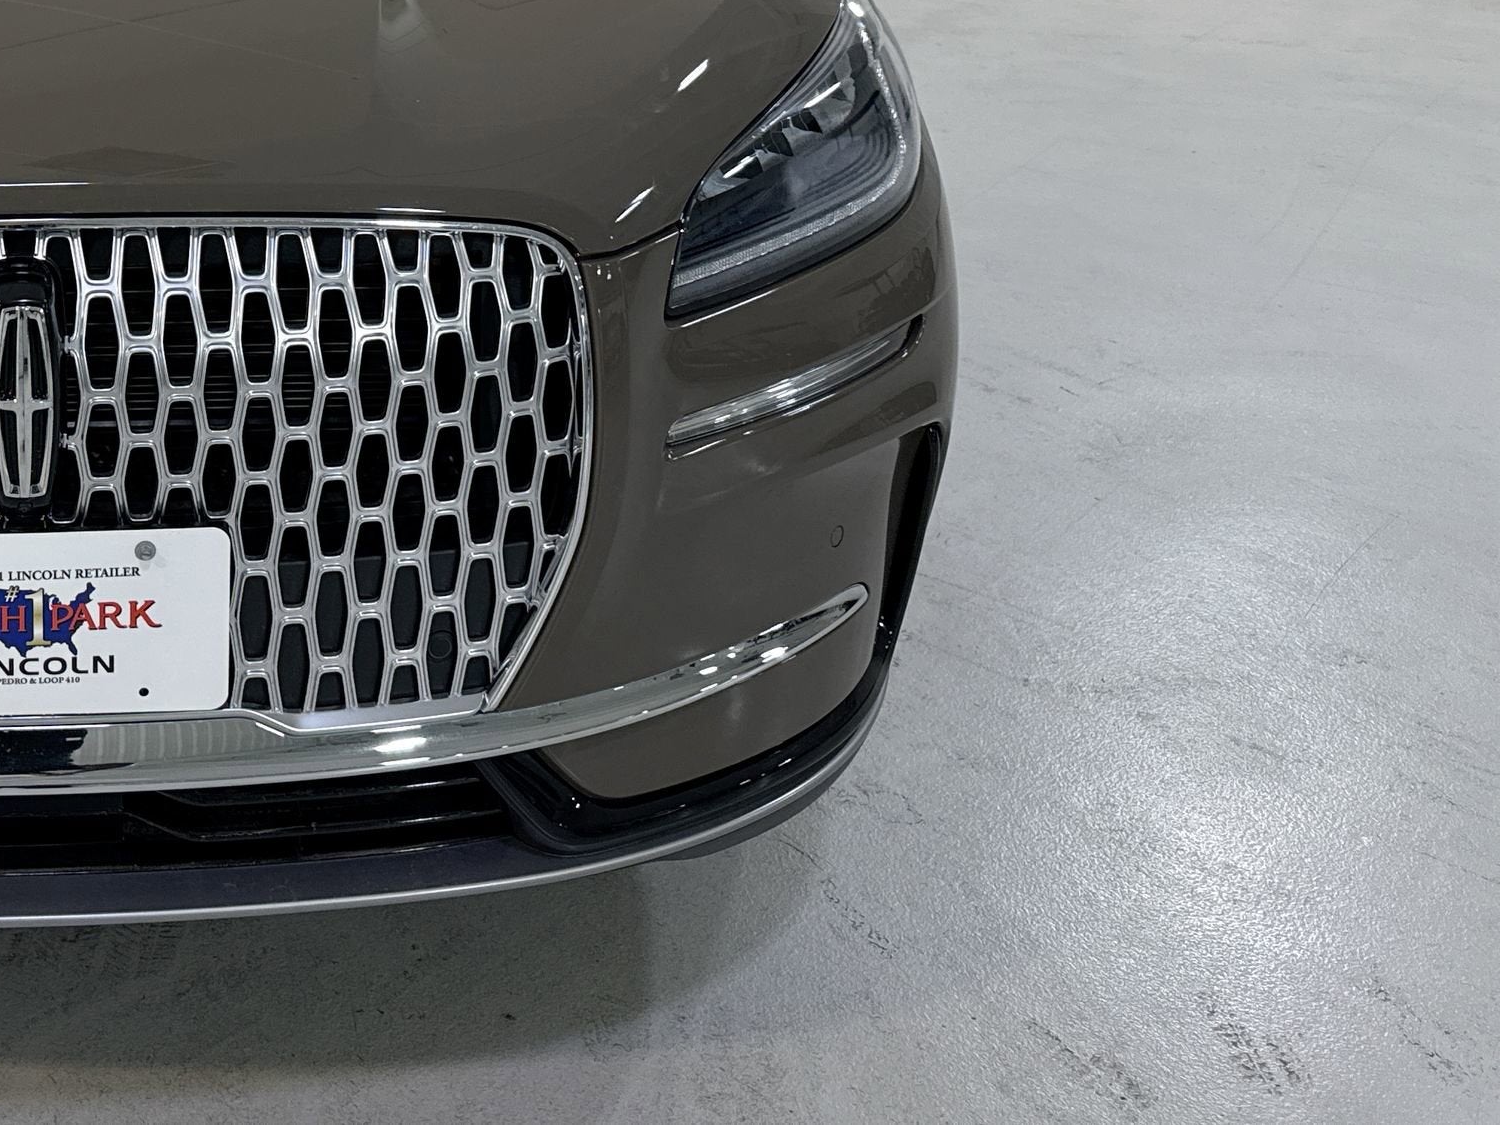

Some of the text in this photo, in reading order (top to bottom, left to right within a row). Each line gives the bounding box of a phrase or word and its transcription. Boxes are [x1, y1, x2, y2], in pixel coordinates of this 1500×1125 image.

[8, 569, 71, 581] LINCOLN
[75, 566, 141, 579] RETAILER
[51, 600, 163, 631] PARK
[29, 677, 37, 685] &
[39, 676, 65, 684] LOOP
[66, 676, 81, 684] 410
